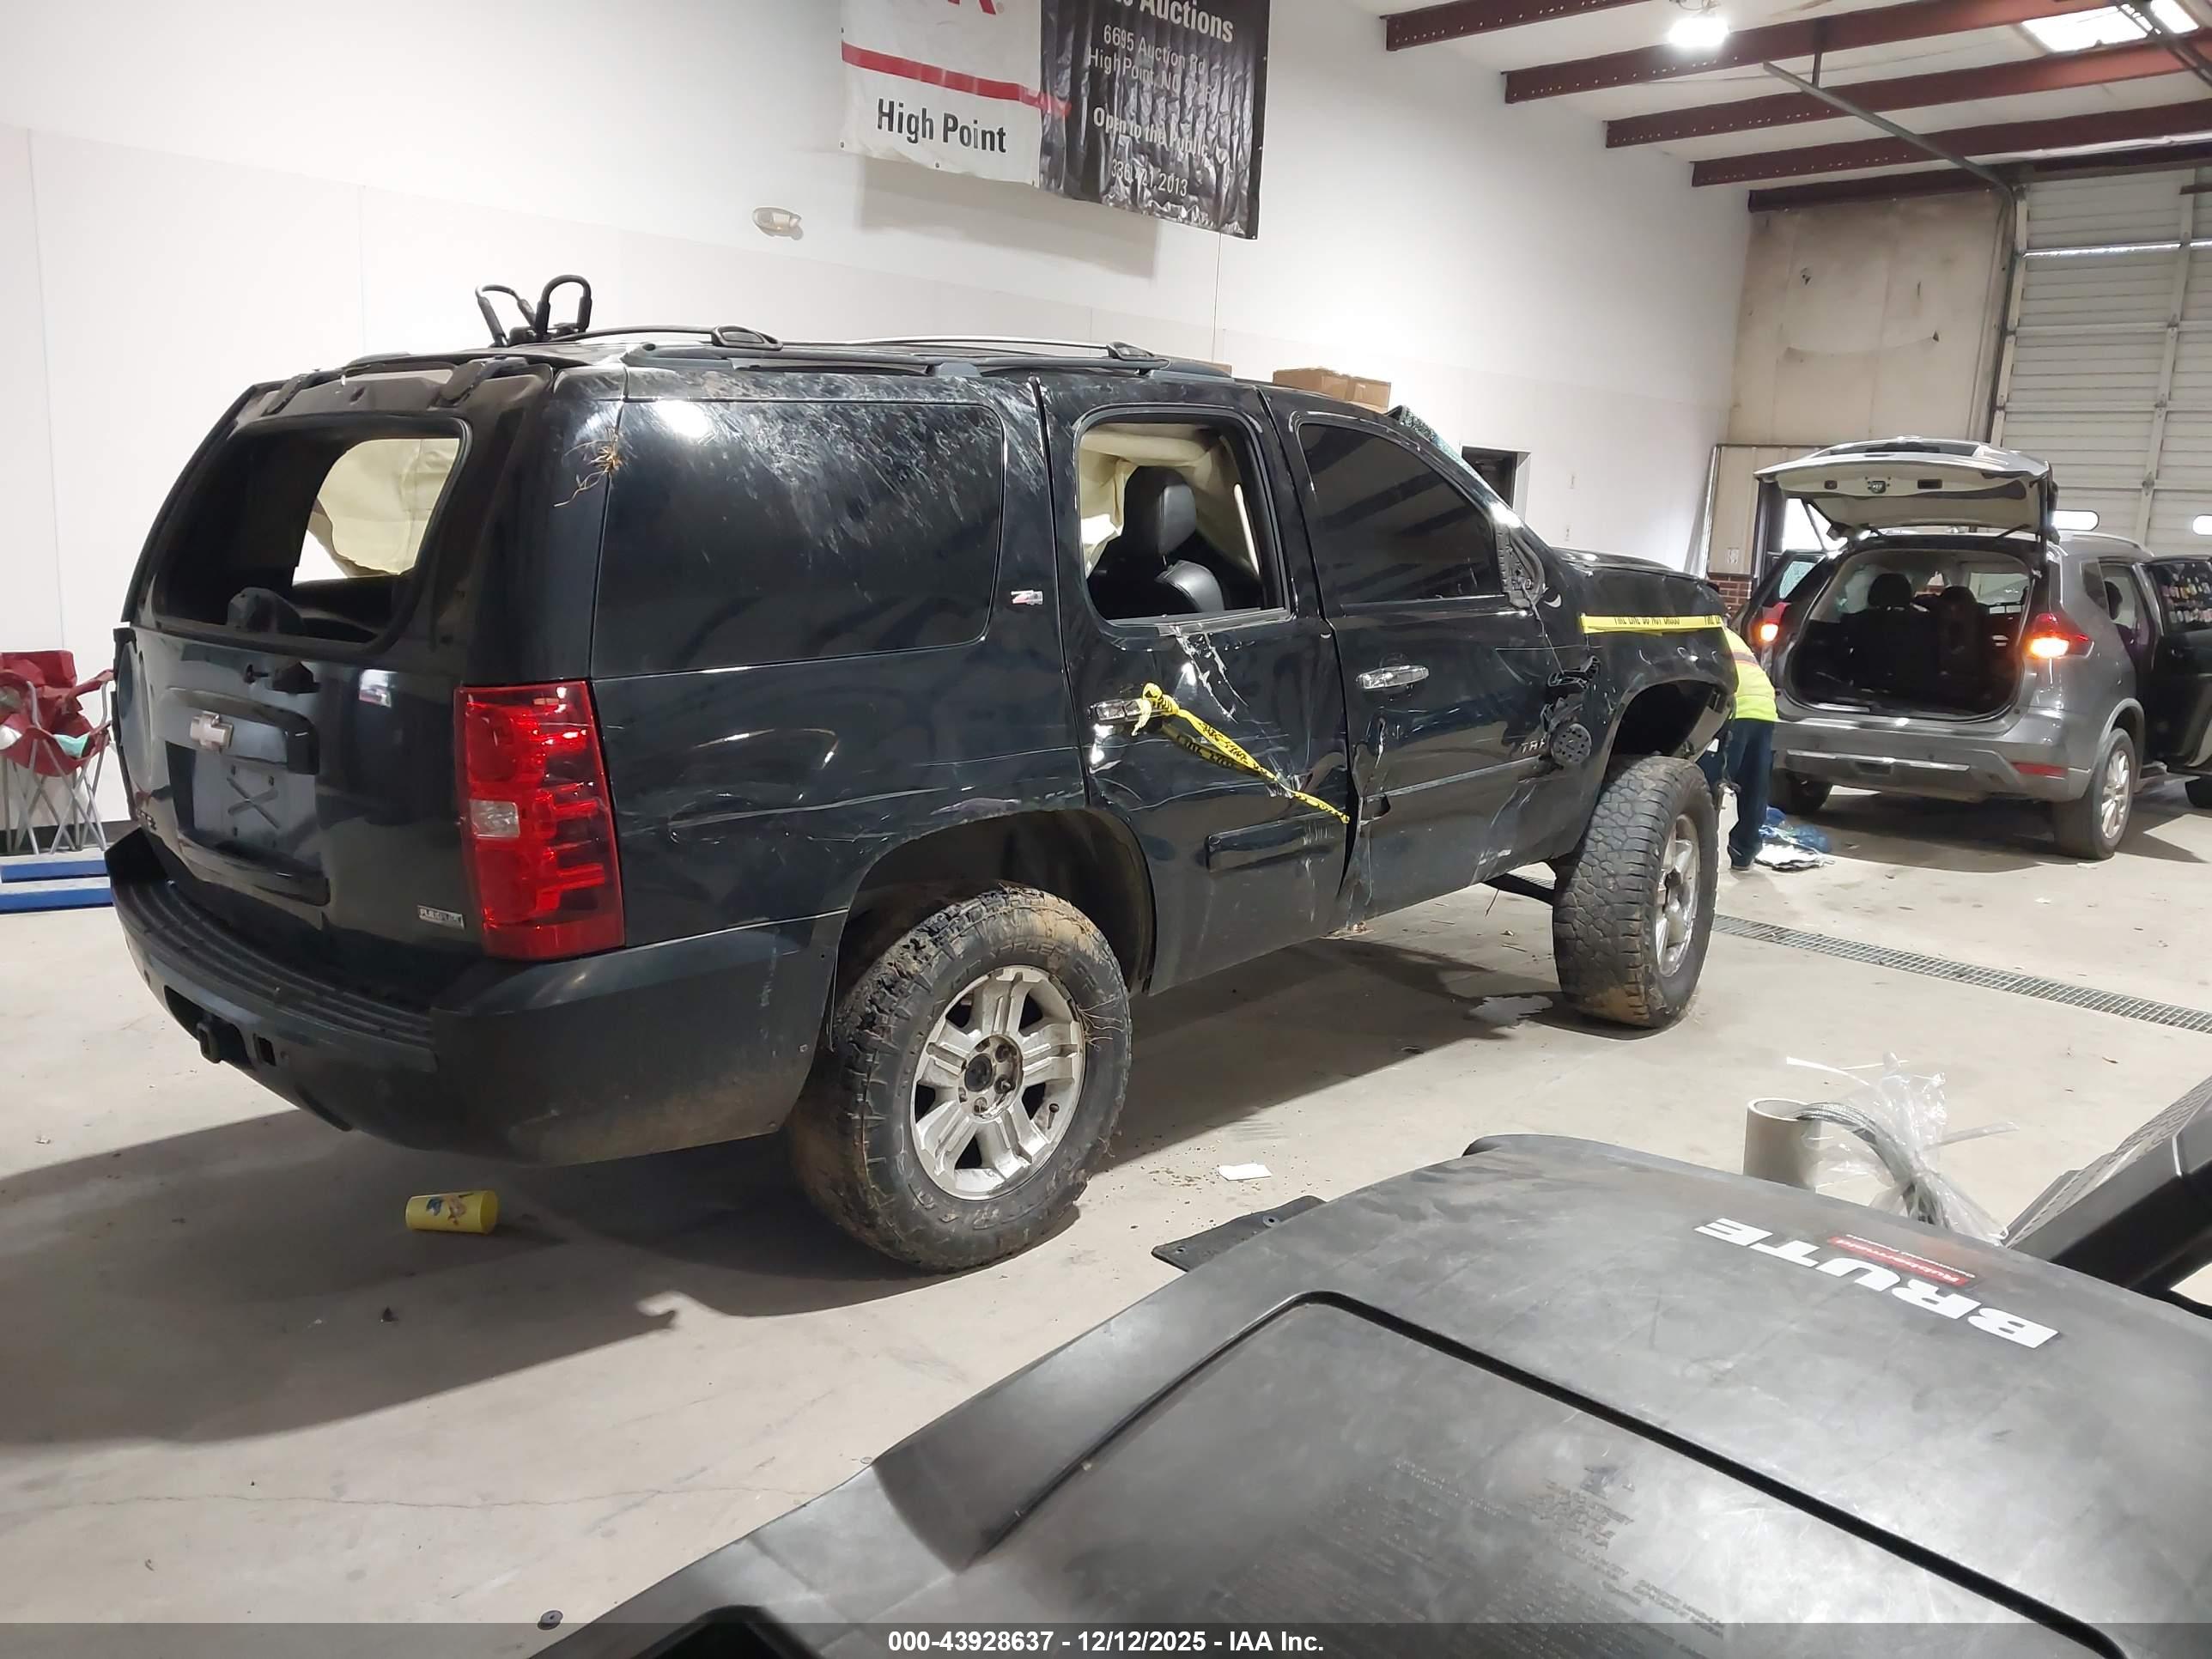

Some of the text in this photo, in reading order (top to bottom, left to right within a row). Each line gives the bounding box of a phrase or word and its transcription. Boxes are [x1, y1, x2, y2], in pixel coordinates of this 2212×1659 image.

[1139, 0, 1234, 43] Auctions
[1087, 46, 1121, 76] High
[1103, 24, 1206, 74] 6695 Auction Rd
[877, 98, 1006, 153] High Point
[1093, 106, 1127, 135] Open
[1145, 123, 1167, 146] the
[1693, 1217, 2059, 1349] BRUTE
